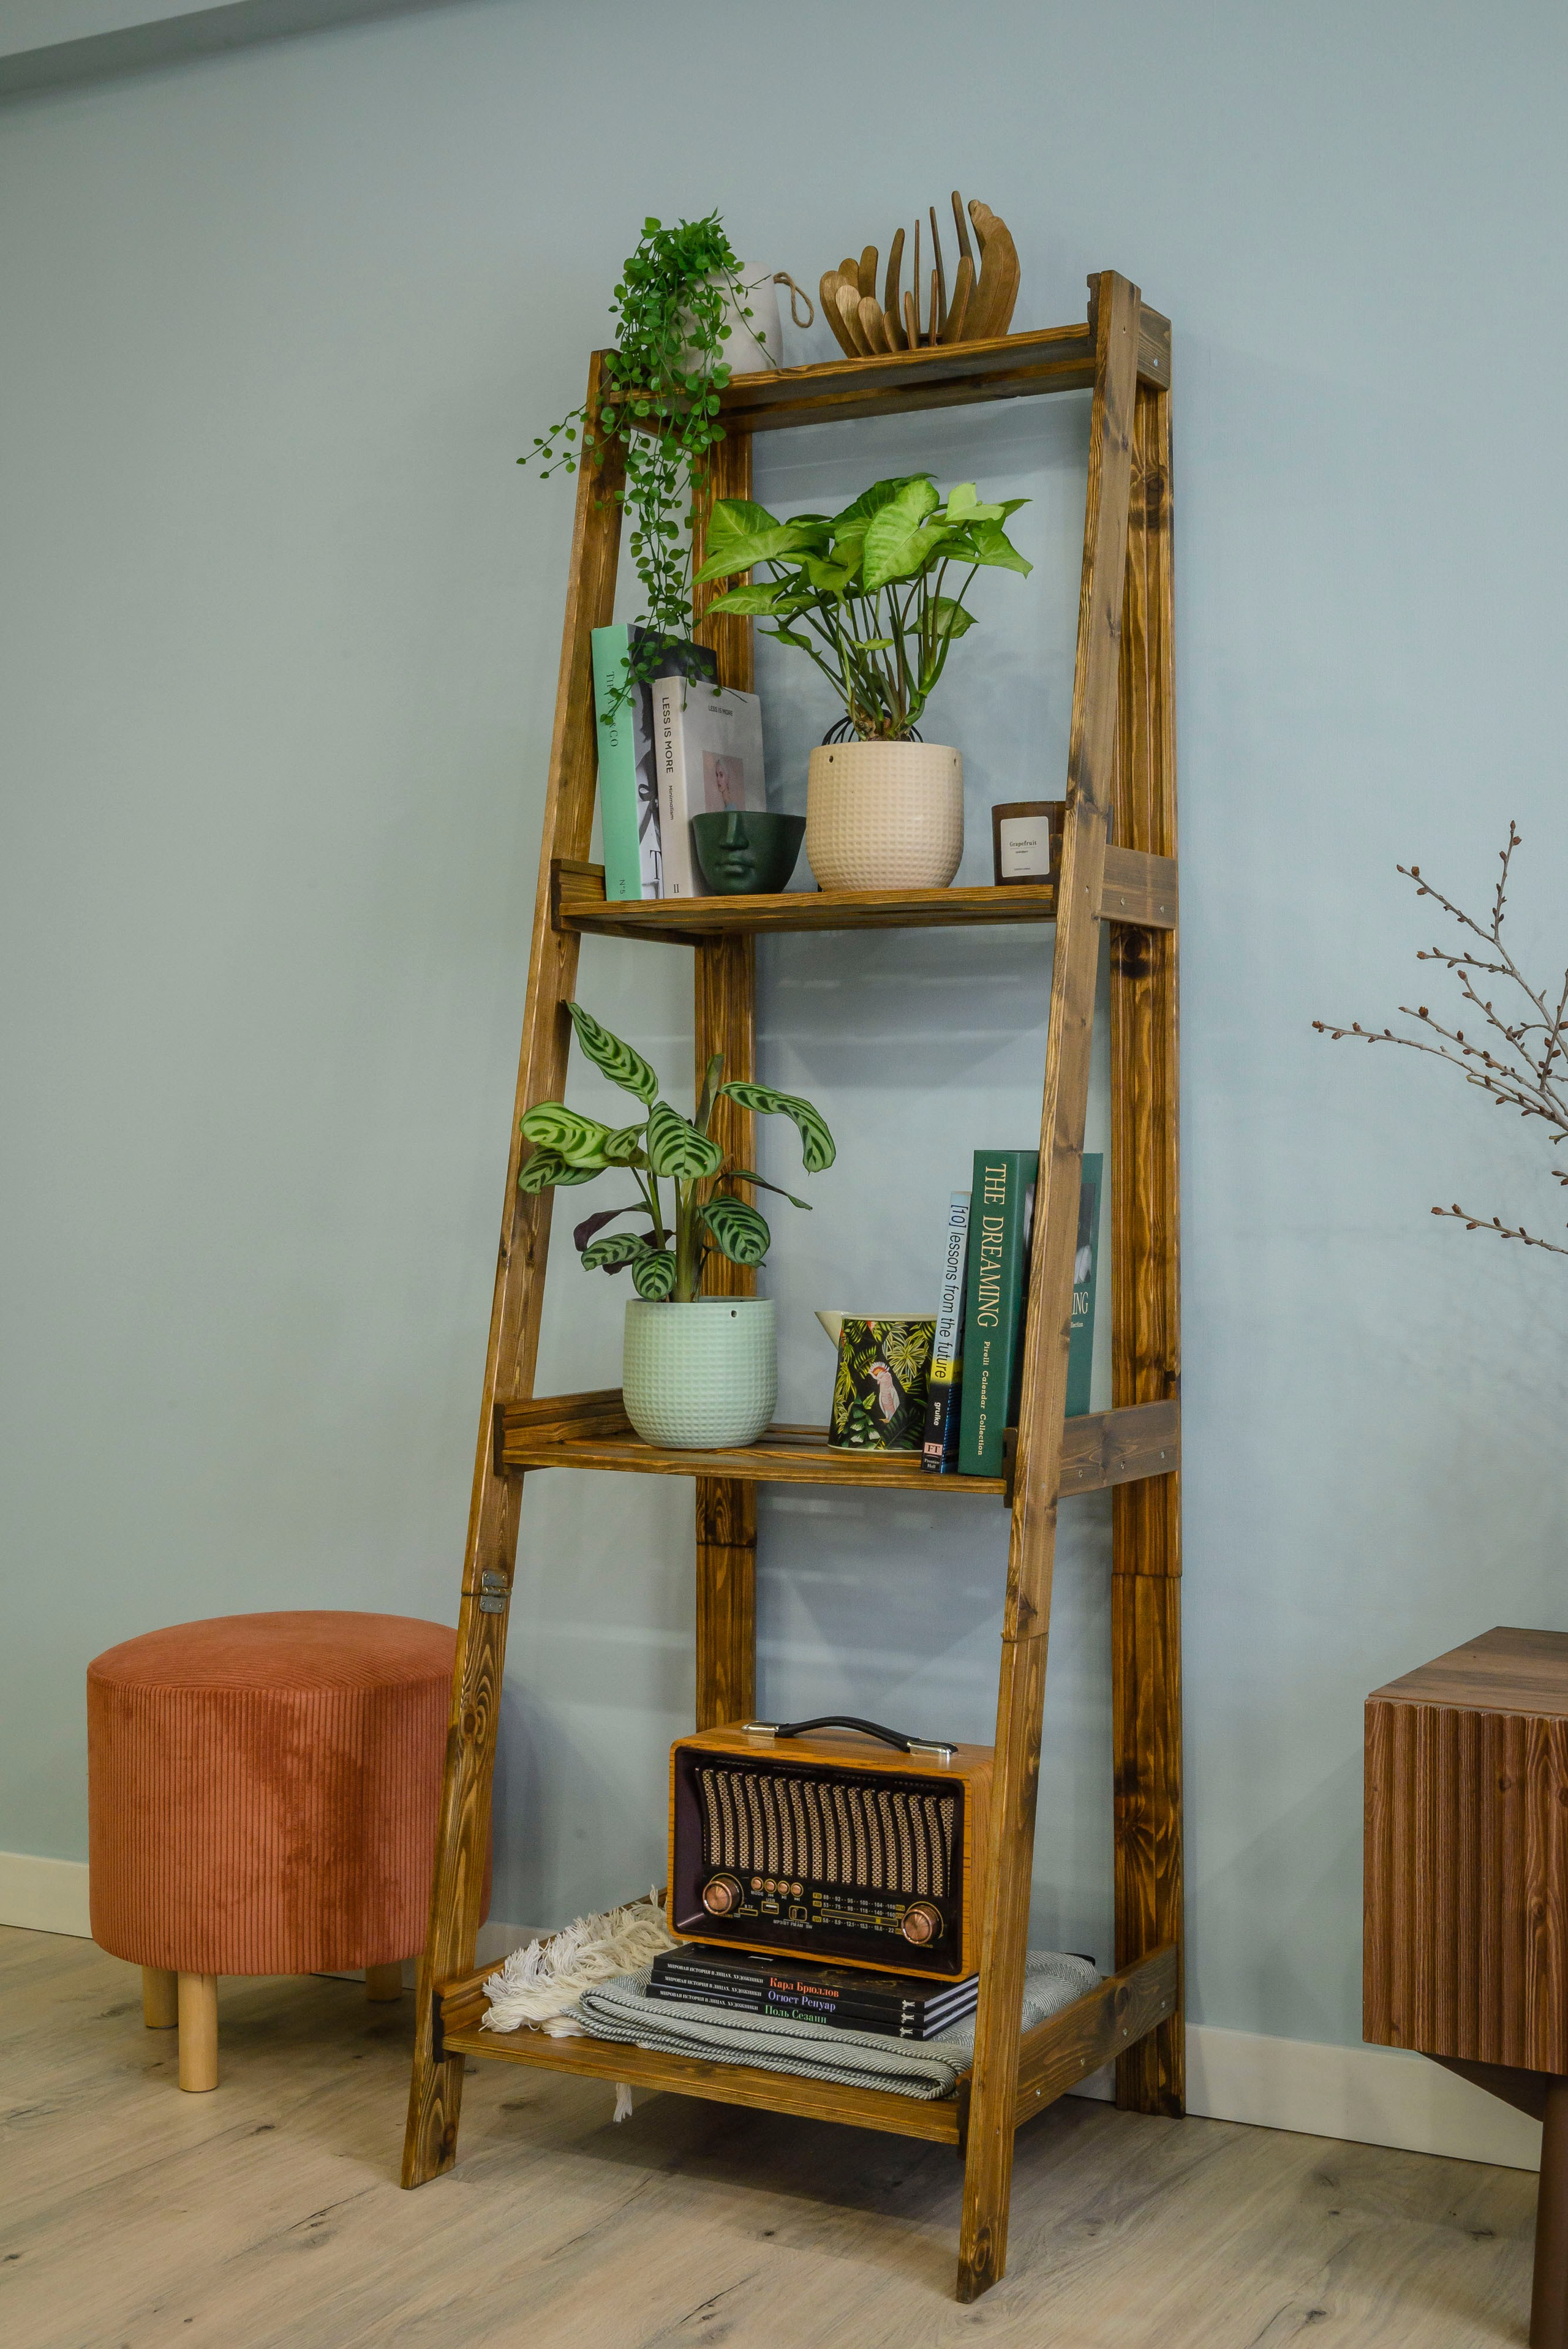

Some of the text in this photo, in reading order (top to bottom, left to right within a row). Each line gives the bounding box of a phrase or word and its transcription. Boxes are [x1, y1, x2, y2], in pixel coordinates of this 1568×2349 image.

[662, 697, 673, 774] LESS IS MORE
[977, 1163, 1007, 1328] THE DREAMING
[935, 1204, 968, 1378] [10] lessons from the future
[928, 1444, 940, 1453] FT
[978, 1414, 986, 1455] Collection
[667, 1963, 689, 1972] МИРОВАЯ
[733, 1974, 763, 1983] ХУДОЖНИКИ
[770, 1977, 794, 1991] Карл
[797, 1982, 839, 1998] Брюллов
[728, 2001, 758, 2011] ХУДОЖНИКИ
[765, 2005, 789, 2018] Поль
[792, 2010, 827, 2024] Сезанн
[731, 1987, 761, 1997] ХУДОЖНИКИ
[768, 1990, 799, 2004] Огюст
[802, 1996, 835, 2013] Ренуар
